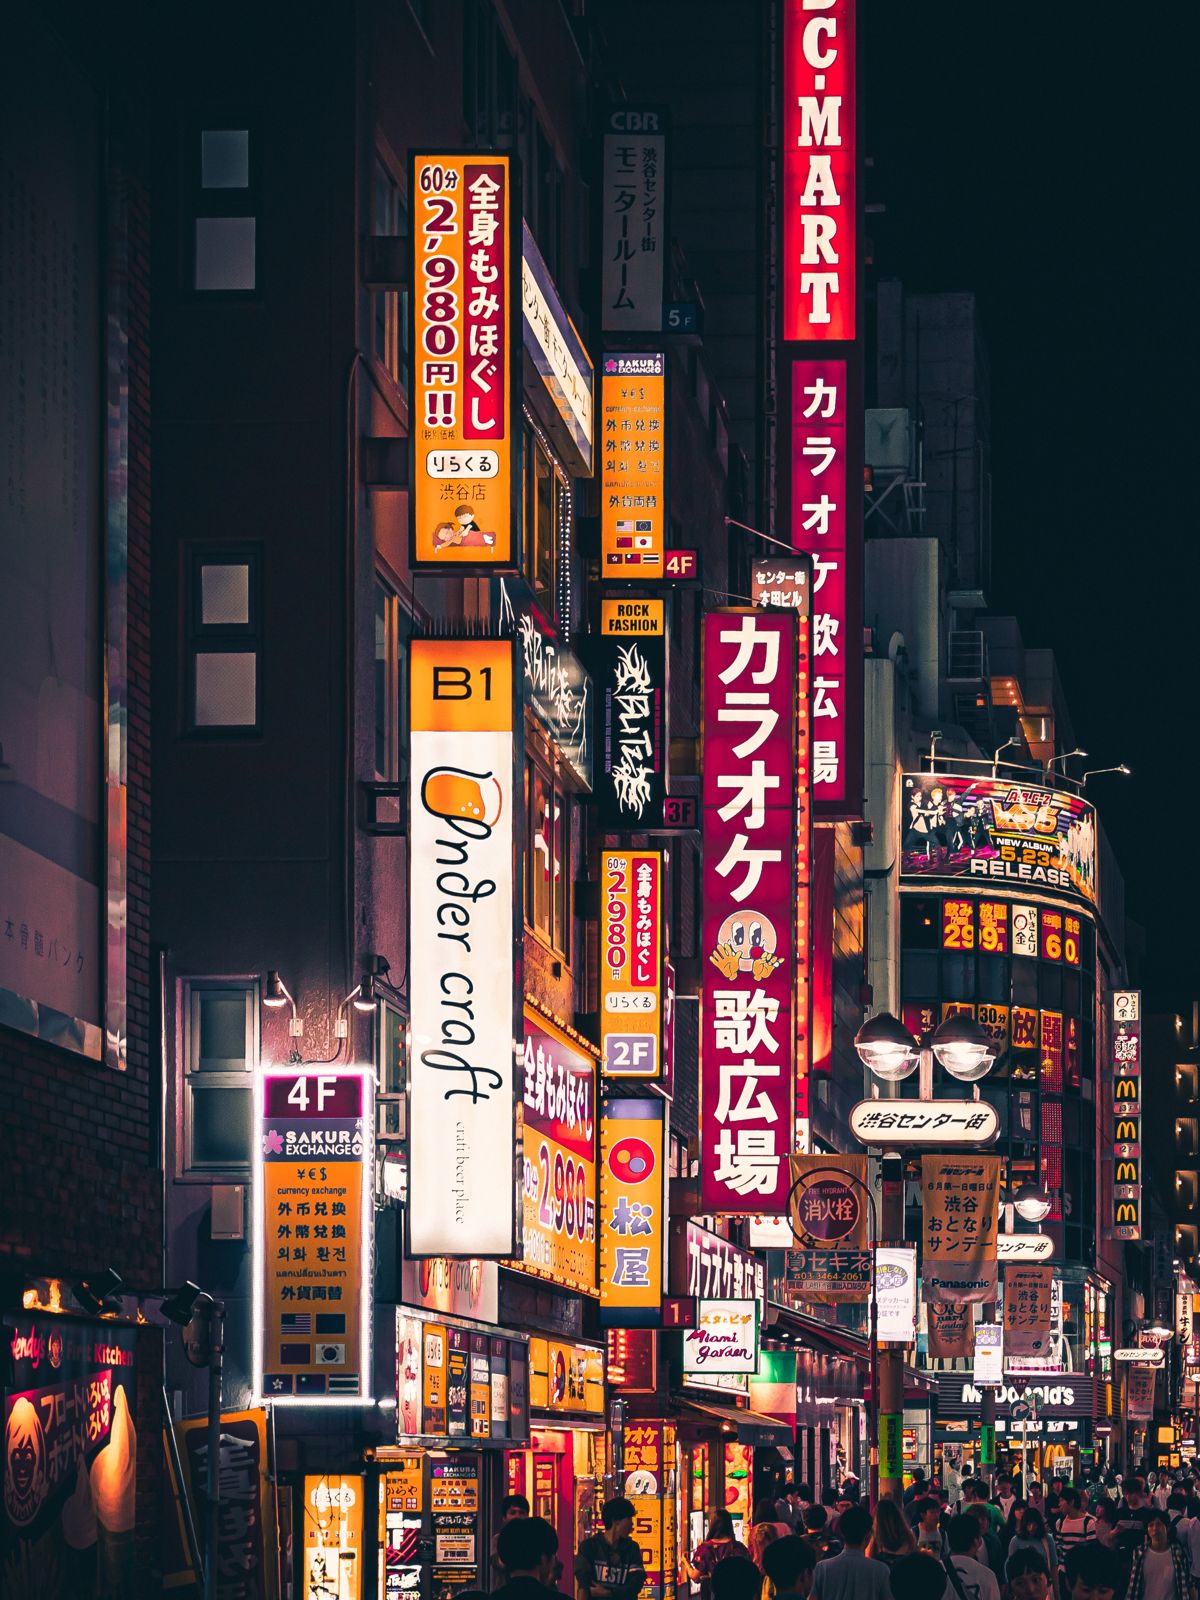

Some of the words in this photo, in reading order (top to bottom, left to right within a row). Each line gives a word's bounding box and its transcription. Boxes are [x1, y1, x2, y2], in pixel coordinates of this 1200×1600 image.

[610, 111, 659, 131] CBR
[420, 166, 458, 193] 60分
[641, 147, 657, 252] 渋谷センター街
[612, 146, 637, 310] モニタールーム
[468, 173, 501, 431] 全身もみほぐし
[433, 456, 491, 472] りらくる
[440, 484, 486, 500] 渋谷店
[667, 556, 692, 574] 4F
[617, 604, 649, 617] ROCK
[609, 619, 658, 631] FASHION
[433, 666, 492, 701] B1
[714, 616, 782, 903] カラオケ
[668, 802, 691, 823] 3F
[997, 837, 1021, 848] NEW
[1023, 840, 1053, 852] ALBUM
[1001, 846, 1051, 867] 5.23
[970, 859, 1071, 887] RELEASE
[636, 863, 653, 982] 全身もみほぐし
[1028, 910, 1037, 953] やきとり
[609, 996, 652, 1008] りらくる
[980, 1007, 1007, 1024] 30分
[613, 1041, 650, 1066] 2F
[287, 1076, 338, 1112] 4F
[524, 1036, 594, 1142] 全身もみほぐし
[713, 988, 781, 1196] 歌広場
[858, 1112, 990, 1130] 渋谷センター街
[286, 1131, 363, 1144] SAKURA
[286, 1145, 351, 1156] EXCHANGE
[277, 1186, 310, 1197] currency
[311, 1186, 347, 1197] exchange
[805, 1199, 854, 1222] 消火栓
[944, 1196, 978, 1213] 渋谷
[928, 1216, 993, 1233] おとなり
[609, 1197, 653, 1286] 松屋
[928, 1236, 993, 1252] サンデー
[277, 1247, 307, 1262] 외화
[316, 1247, 347, 1262] 환전
[808, 1252, 872, 1272] セキネ
[931, 1278, 990, 1289] Panasonic
[281, 1286, 343, 1301] 外貨両替
[1018, 1290, 1039, 1301] 渋谷
[670, 1303, 691, 1324] 1F
[1008, 1303, 1048, 1314] おとなり
[1008, 1315, 1049, 1326] サンデー
[686, 1330, 739, 1344] Miami
[94, 1344, 134, 1366] Kitchen
